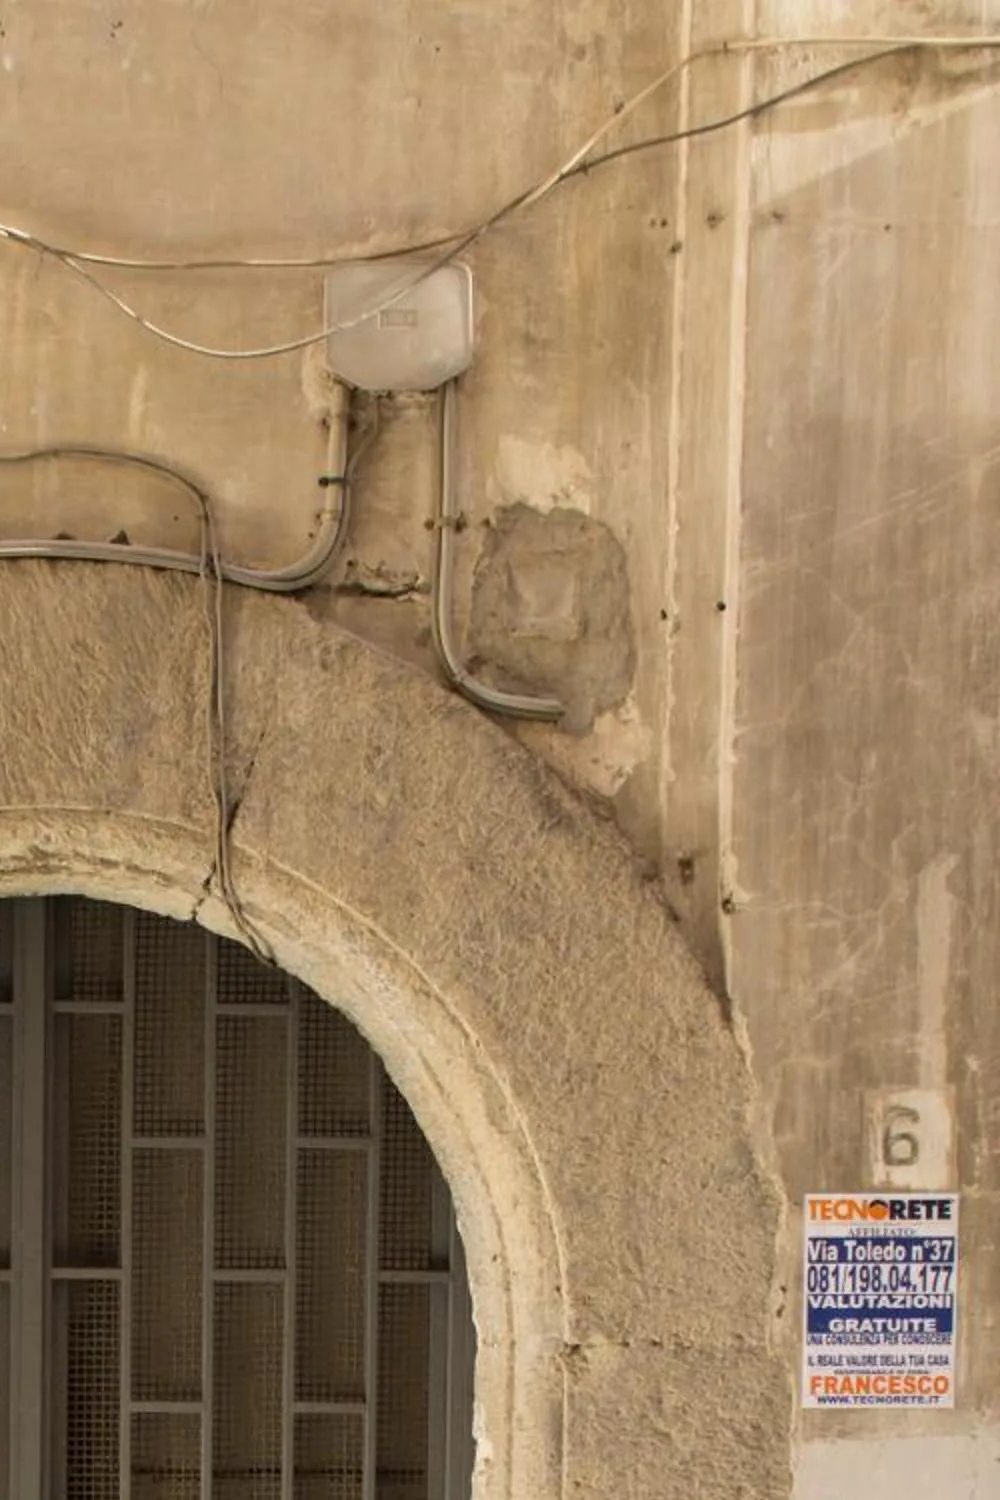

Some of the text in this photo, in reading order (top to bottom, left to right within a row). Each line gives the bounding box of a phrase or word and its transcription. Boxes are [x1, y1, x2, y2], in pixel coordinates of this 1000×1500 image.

[883, 1105, 920, 1166] 6
[808, 1200, 951, 1220] TECNORETE
[808, 1240, 838, 1262] Via
[844, 1240, 907, 1262] Toledo
[807, 1265, 953, 1292] 081/198.04.177
[809, 1295, 951, 1309] VALUTAZIONI
[829, 1318, 937, 1332] GRATUITE
[817, 1355, 843, 1366] REALE
[846, 1355, 877, 1366] VALORE
[880, 1355, 905, 1366] DELLA
[908, 1355, 925, 1366] TUA
[810, 1375, 949, 1394] FRANCESCO
[817, 1395, 940, 1405] WWW.TECNORETE.IT
